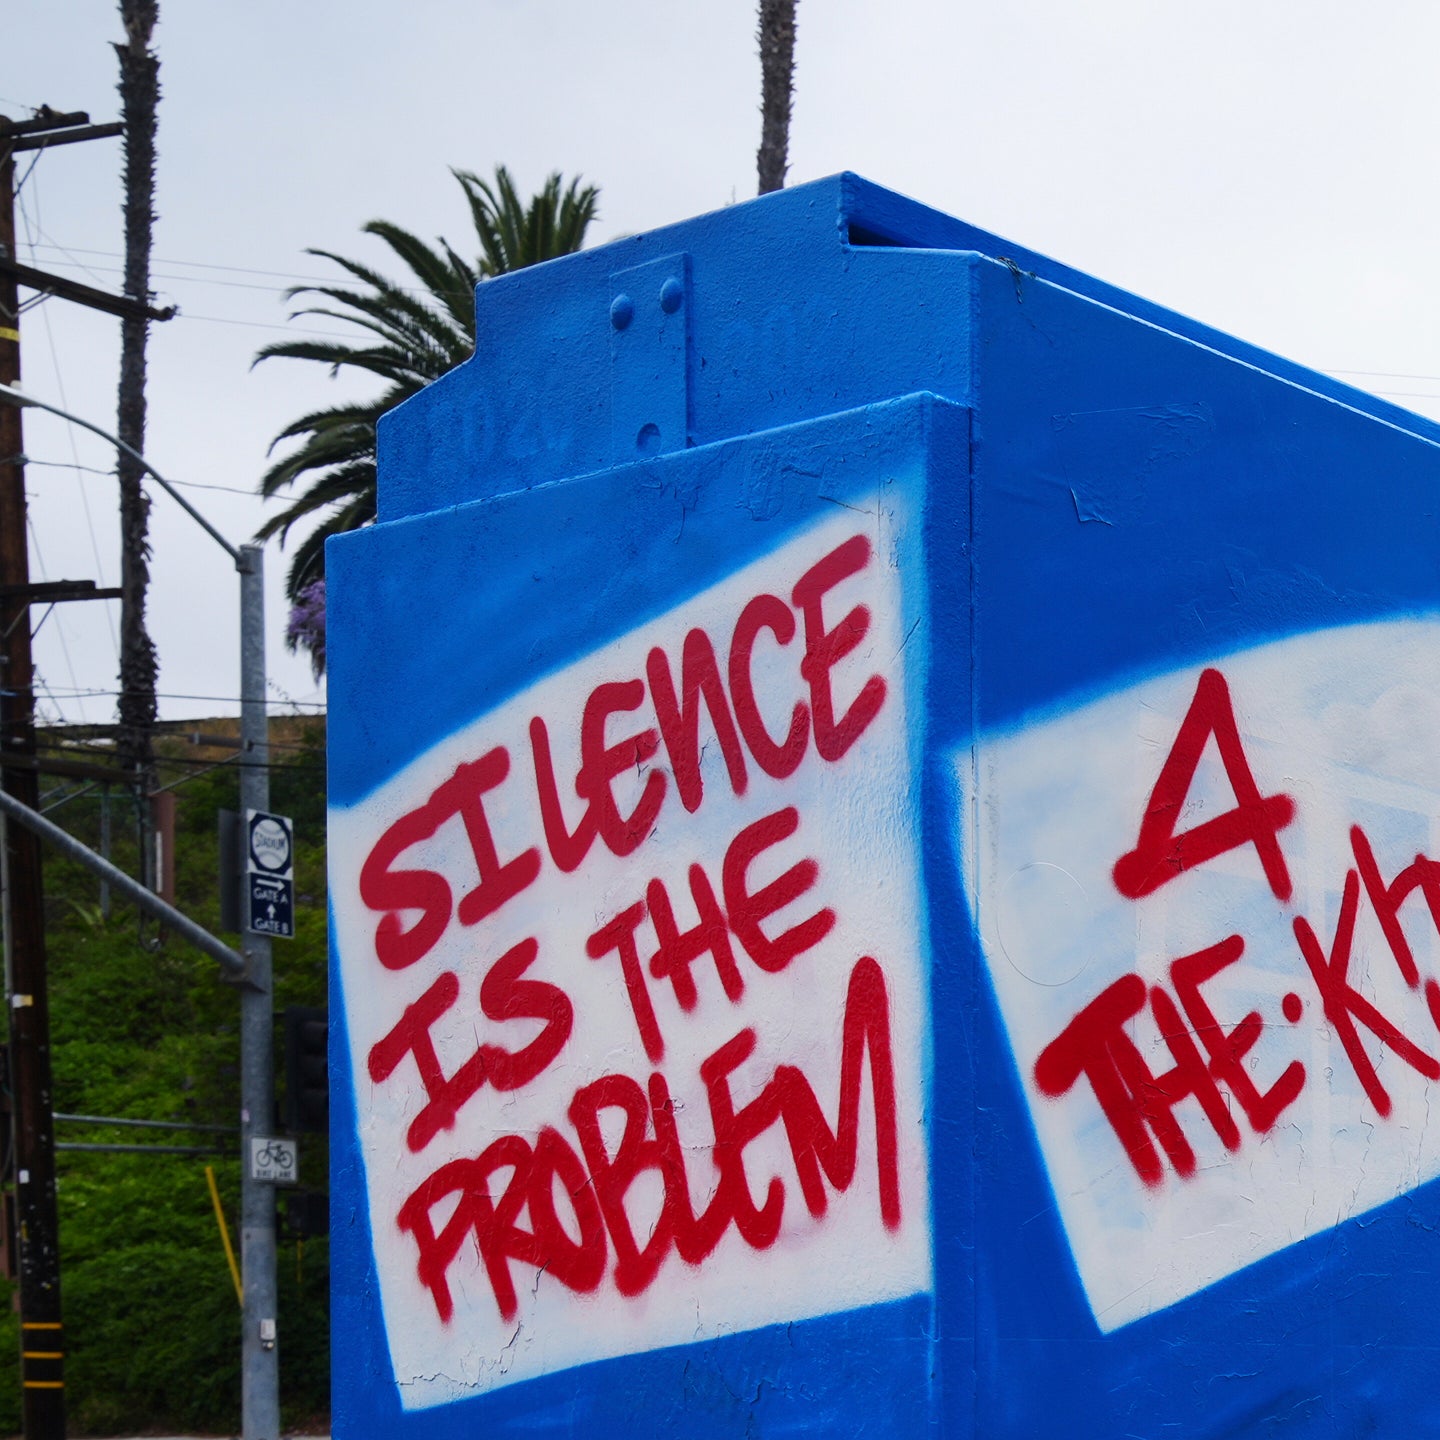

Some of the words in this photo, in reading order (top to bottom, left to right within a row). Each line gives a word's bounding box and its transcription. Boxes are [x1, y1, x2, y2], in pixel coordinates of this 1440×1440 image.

[253, 887, 279, 903] GATE
[280, 893, 289, 905] A
[359, 533, 887, 971] SILENCE
[1110, 667, 1295, 903] 4
[254, 917, 280, 933] GATE
[281, 922, 289, 935] B
[367, 936, 574, 1154] IS
[585, 805, 837, 1064] THE
[396, 956, 902, 1325] PROBLEM
